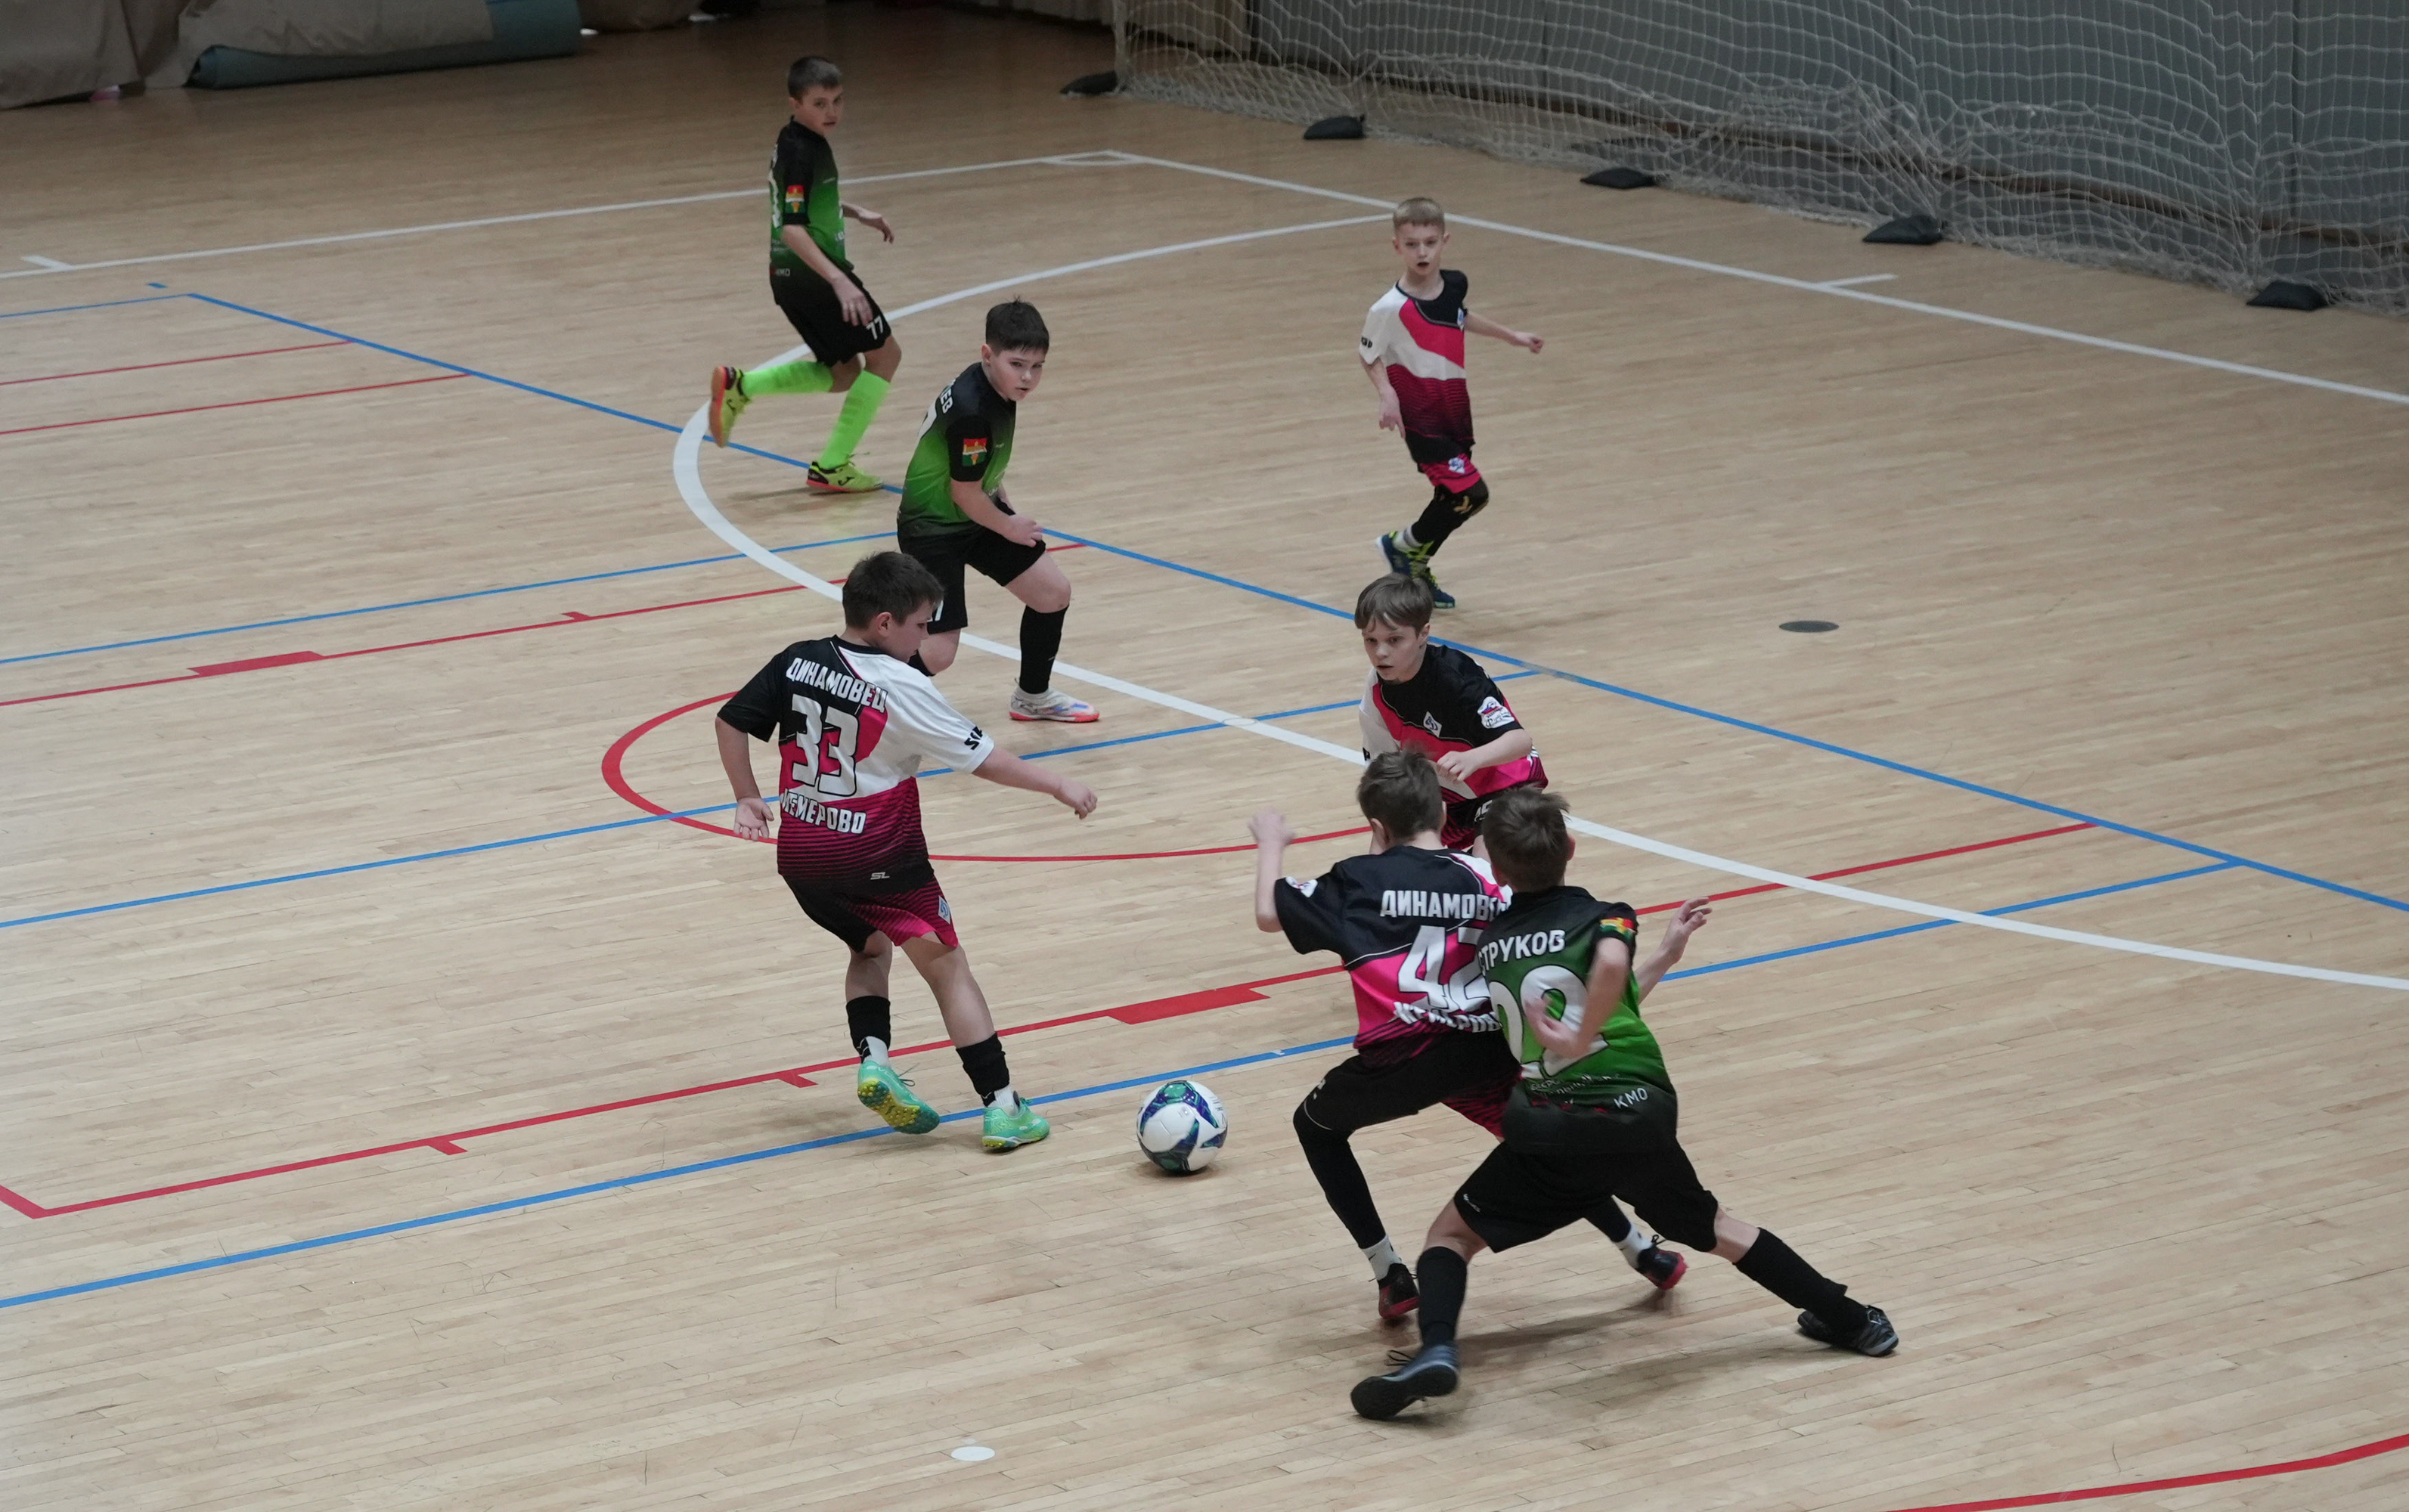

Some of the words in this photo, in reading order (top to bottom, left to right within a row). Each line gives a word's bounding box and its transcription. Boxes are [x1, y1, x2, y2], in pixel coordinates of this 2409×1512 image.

[866, 315, 884, 340] 77
[786, 656, 888, 714] ДИНАМОВЕЦ
[792, 693, 860, 797] 33
[780, 788, 867, 834] КЕМЕРОВО
[870, 872, 890, 881] SL
[1399, 925, 1491, 1014] 42
[1478, 929, 1566, 977] СТРУКОВ
